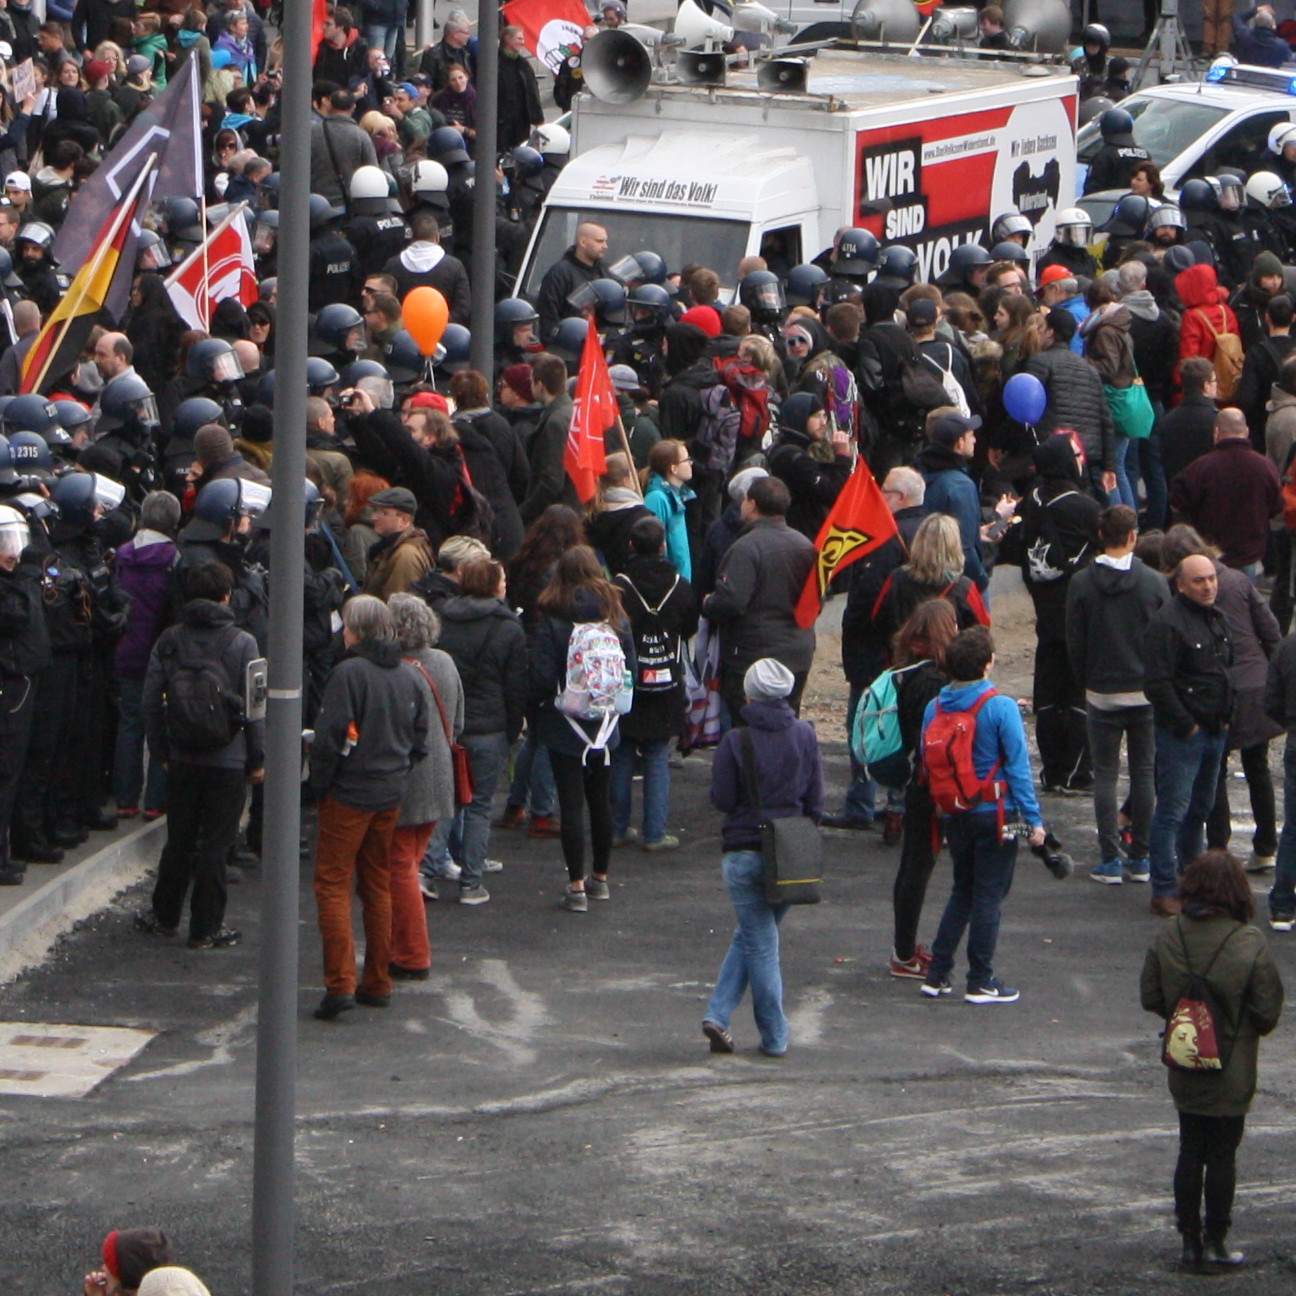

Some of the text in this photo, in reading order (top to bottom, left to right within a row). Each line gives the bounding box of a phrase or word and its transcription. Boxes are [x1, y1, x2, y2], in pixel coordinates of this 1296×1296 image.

[619, 176, 640, 196] Wir
[640, 179, 666, 199] sind
[665, 181, 688, 201] das
[687, 182, 719, 204] Volk!
[865, 150, 916, 201] WIR
[886, 205, 925, 240] SIND
